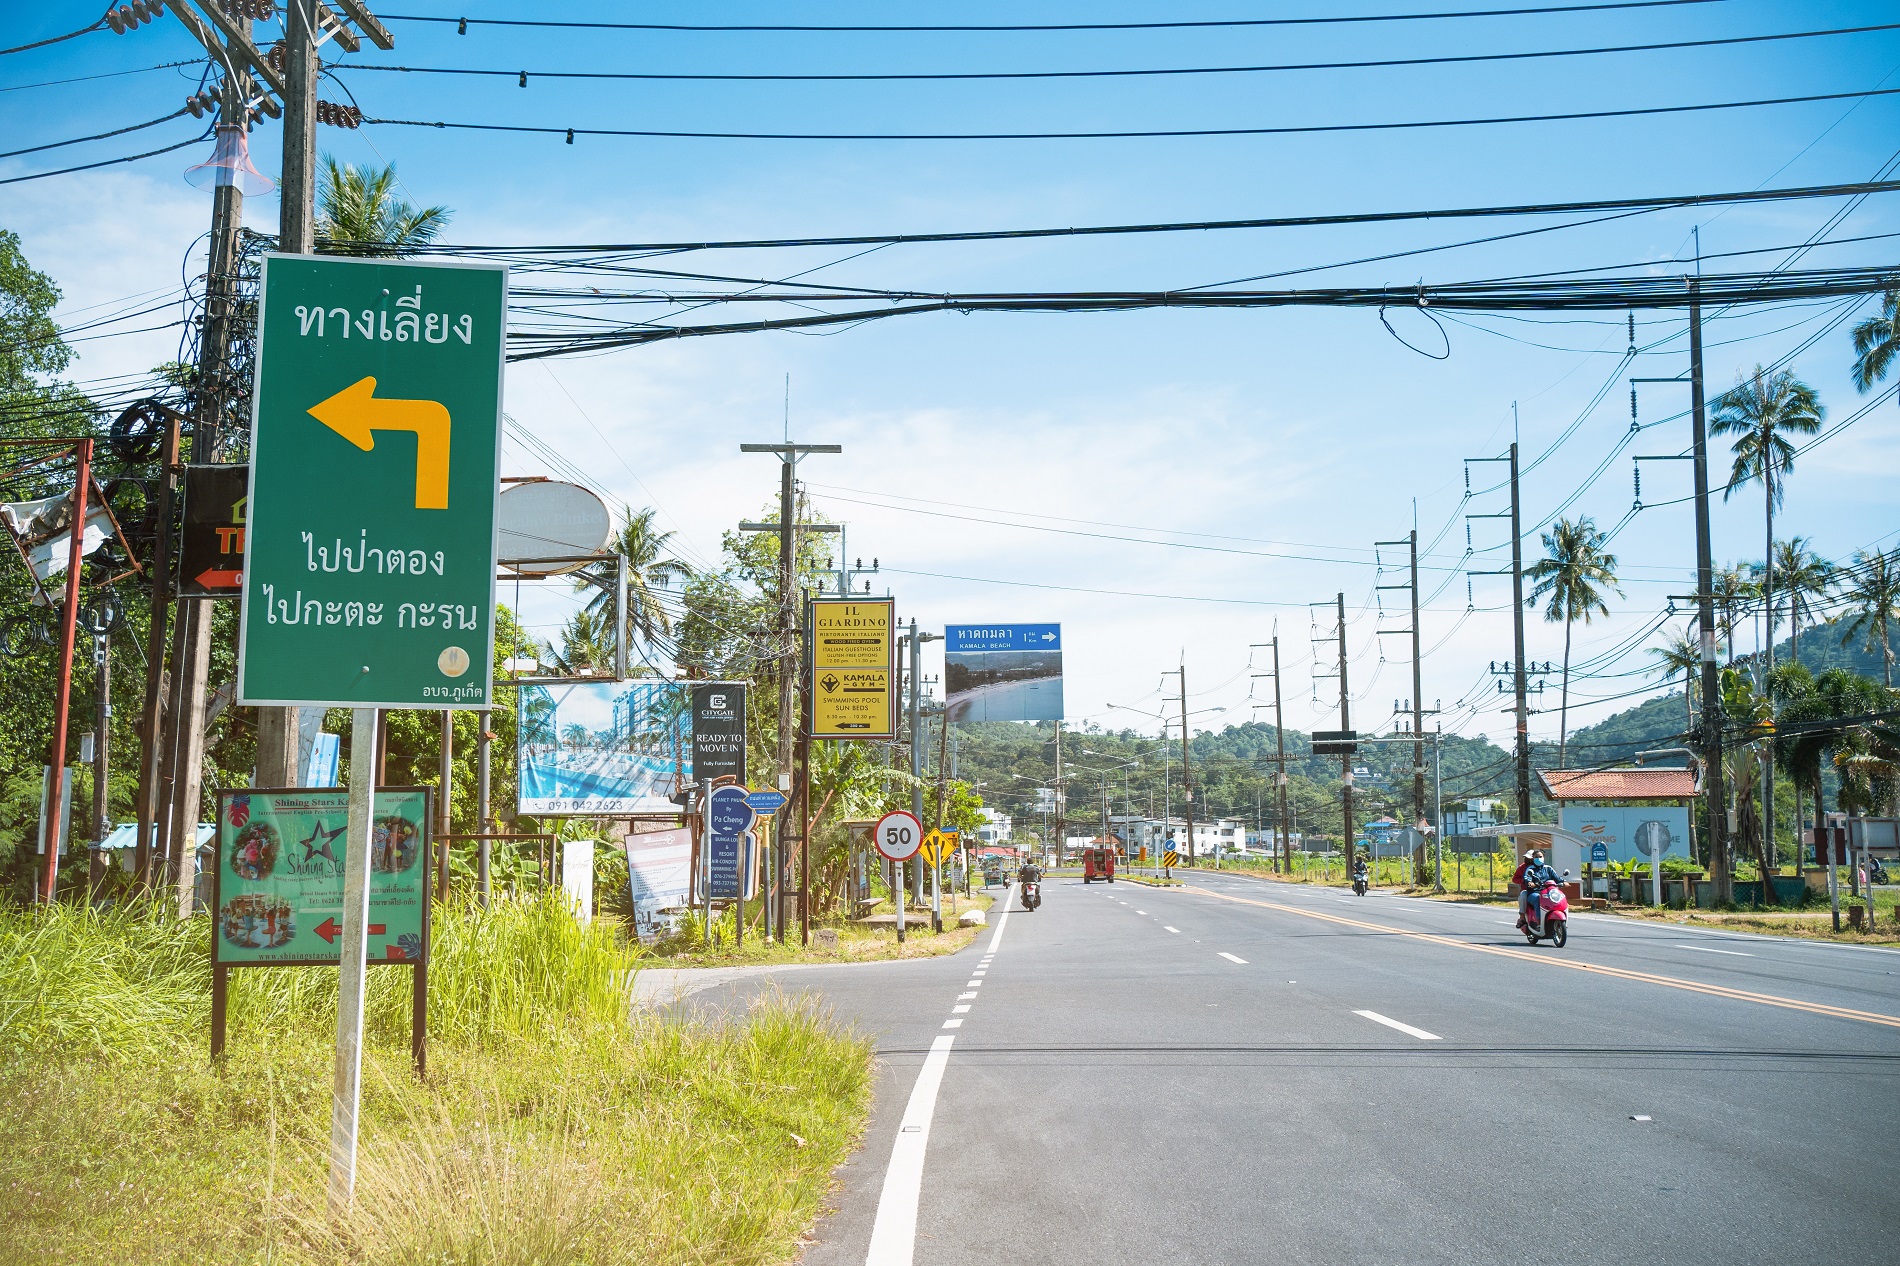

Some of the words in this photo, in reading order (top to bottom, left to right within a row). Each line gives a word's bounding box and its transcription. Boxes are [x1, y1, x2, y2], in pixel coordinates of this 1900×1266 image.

[294, 285, 473, 345] ทางเลี่ยง
[302, 529, 445, 576] ไปป่าตอง
[262, 584, 384, 627] ไปกะตะ
[398, 602, 478, 630] กะรน
[845, 606, 860, 615] IL
[958, 629, 1013, 639] หาดกมลา
[1024, 633, 1027, 642] 1
[423, 684, 483, 703] อบจ.ภูเก็ต
[696, 734, 728, 742] READY
[729, 734, 742, 742] TO
[699, 744, 728, 752] MOVE
[729, 744, 739, 752] IN
[275, 798, 310, 808] Shining
[311, 798, 335, 806] Stars
[337, 798, 350, 806] Ka
[548, 801, 567, 811] 091
[572, 801, 593, 810] 042
[595, 801, 623, 810] 2623
[723, 816, 744, 824] Cheng
[886, 827, 912, 845] 50
[287, 853, 324, 875] Shining
[327, 855, 347, 874] Sta
